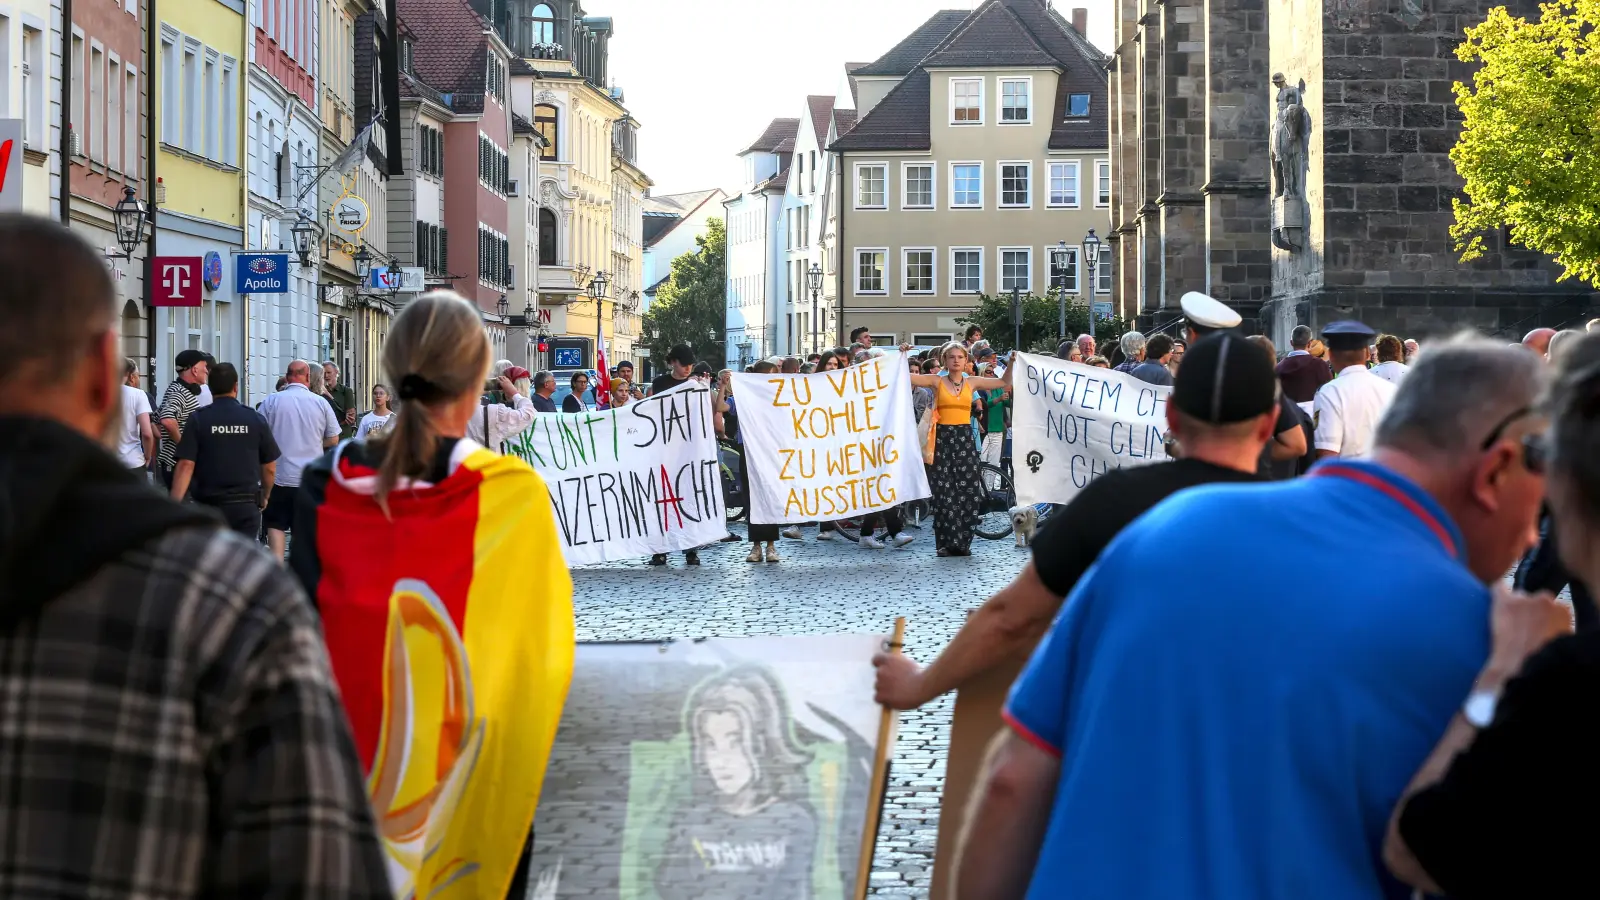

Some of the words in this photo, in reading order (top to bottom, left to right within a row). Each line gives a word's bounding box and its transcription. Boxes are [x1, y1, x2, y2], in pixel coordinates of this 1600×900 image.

[244, 278, 281, 290] Apollo
[768, 377, 811, 406] ZU
[1027, 365, 1122, 413] SYSTEM
[211, 425, 249, 434] POLIZEI
[632, 387, 709, 448] STATT
[792, 396, 880, 439] KOHLE
[1047, 410, 1096, 448] NOT
[1110, 421, 1168, 459] CLIM
[779, 448, 815, 480] ZU
[545, 459, 717, 547] NZERNMACHT
